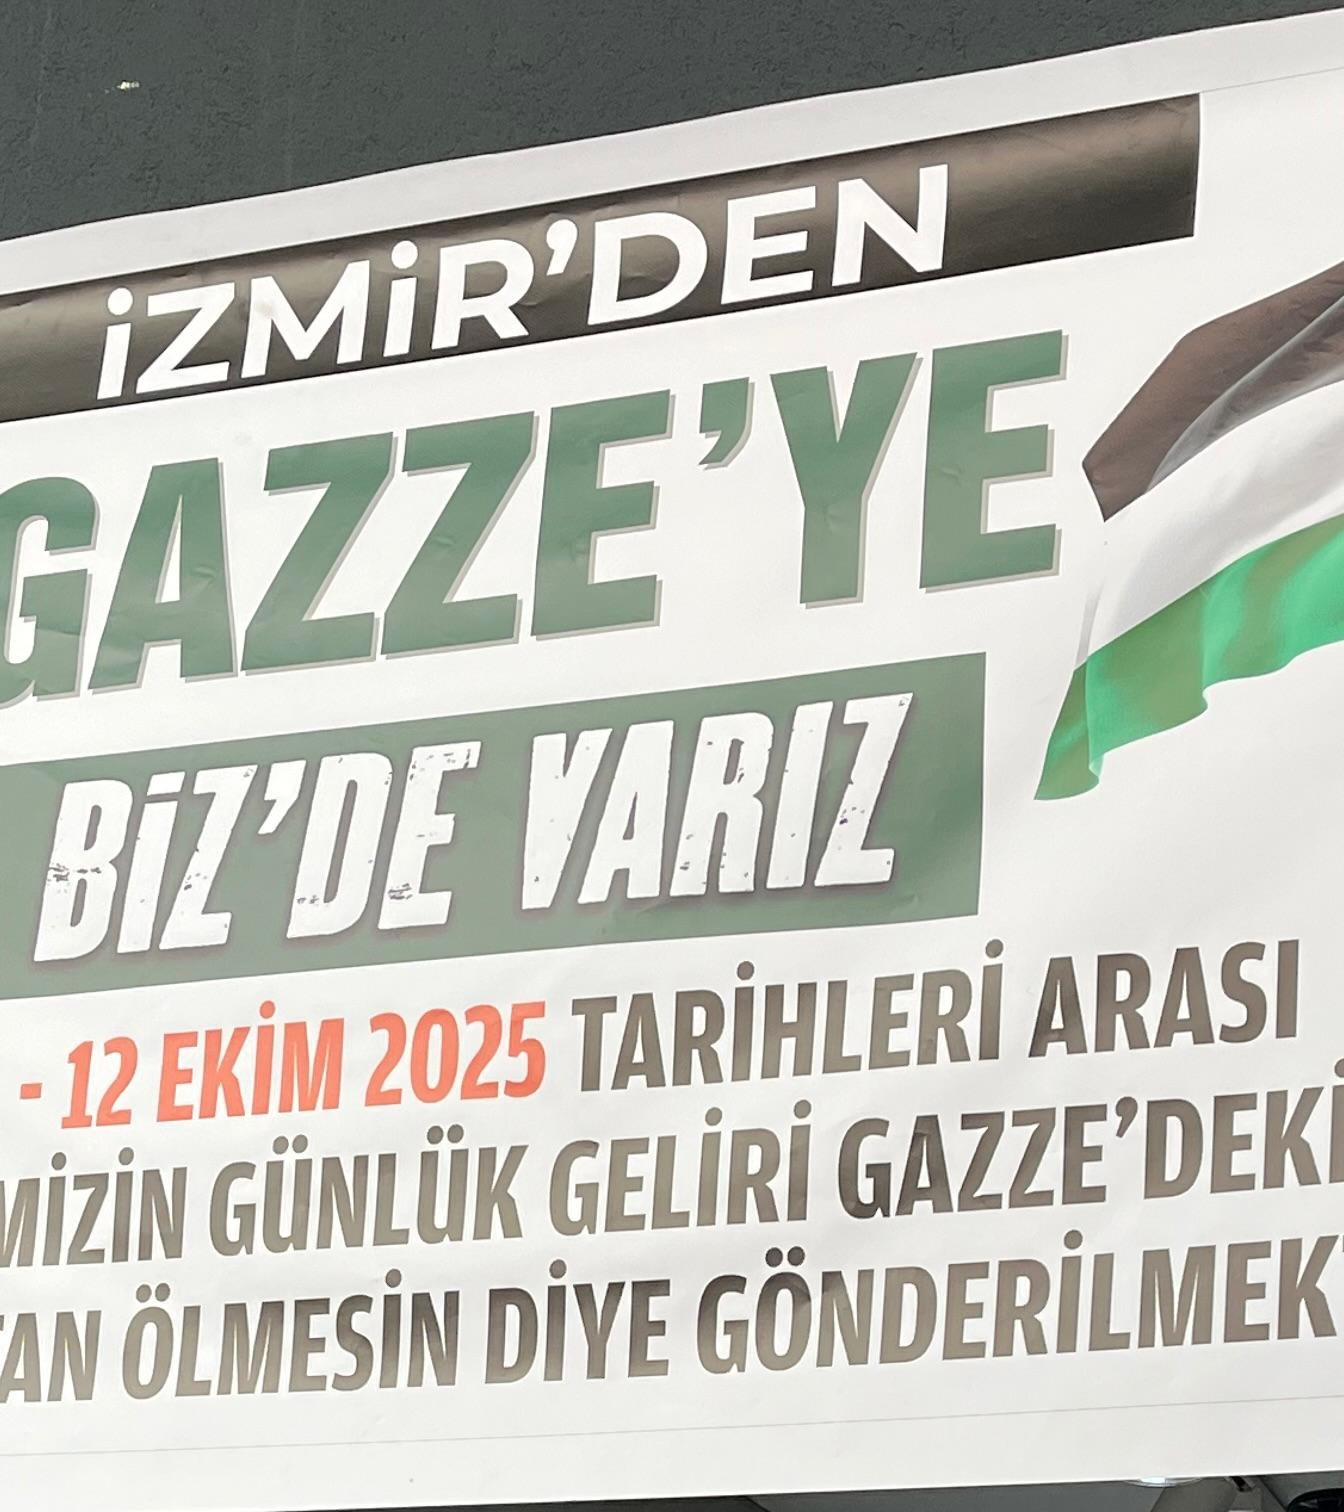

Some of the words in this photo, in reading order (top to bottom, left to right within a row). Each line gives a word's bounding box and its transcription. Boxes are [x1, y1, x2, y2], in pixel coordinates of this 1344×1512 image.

[521, 692, 915, 911] VARIZ
[19, 1082, 42, 1101] -
[59, 1036, 137, 1132] 12
[155, 1000, 346, 1124] EKİM
[365, 1000, 548, 1108] 2025
[571, 938, 1003, 1093] TARİHLERİ
[1027, 938, 1301, 1059] ARASI
[208, 1123, 529, 1257] GÜNLÜK
[550, 1098, 812, 1237] GELİRİ
[121, 1267, 459, 1402] ÖLMESİN
[483, 1258, 670, 1384] DİYE
